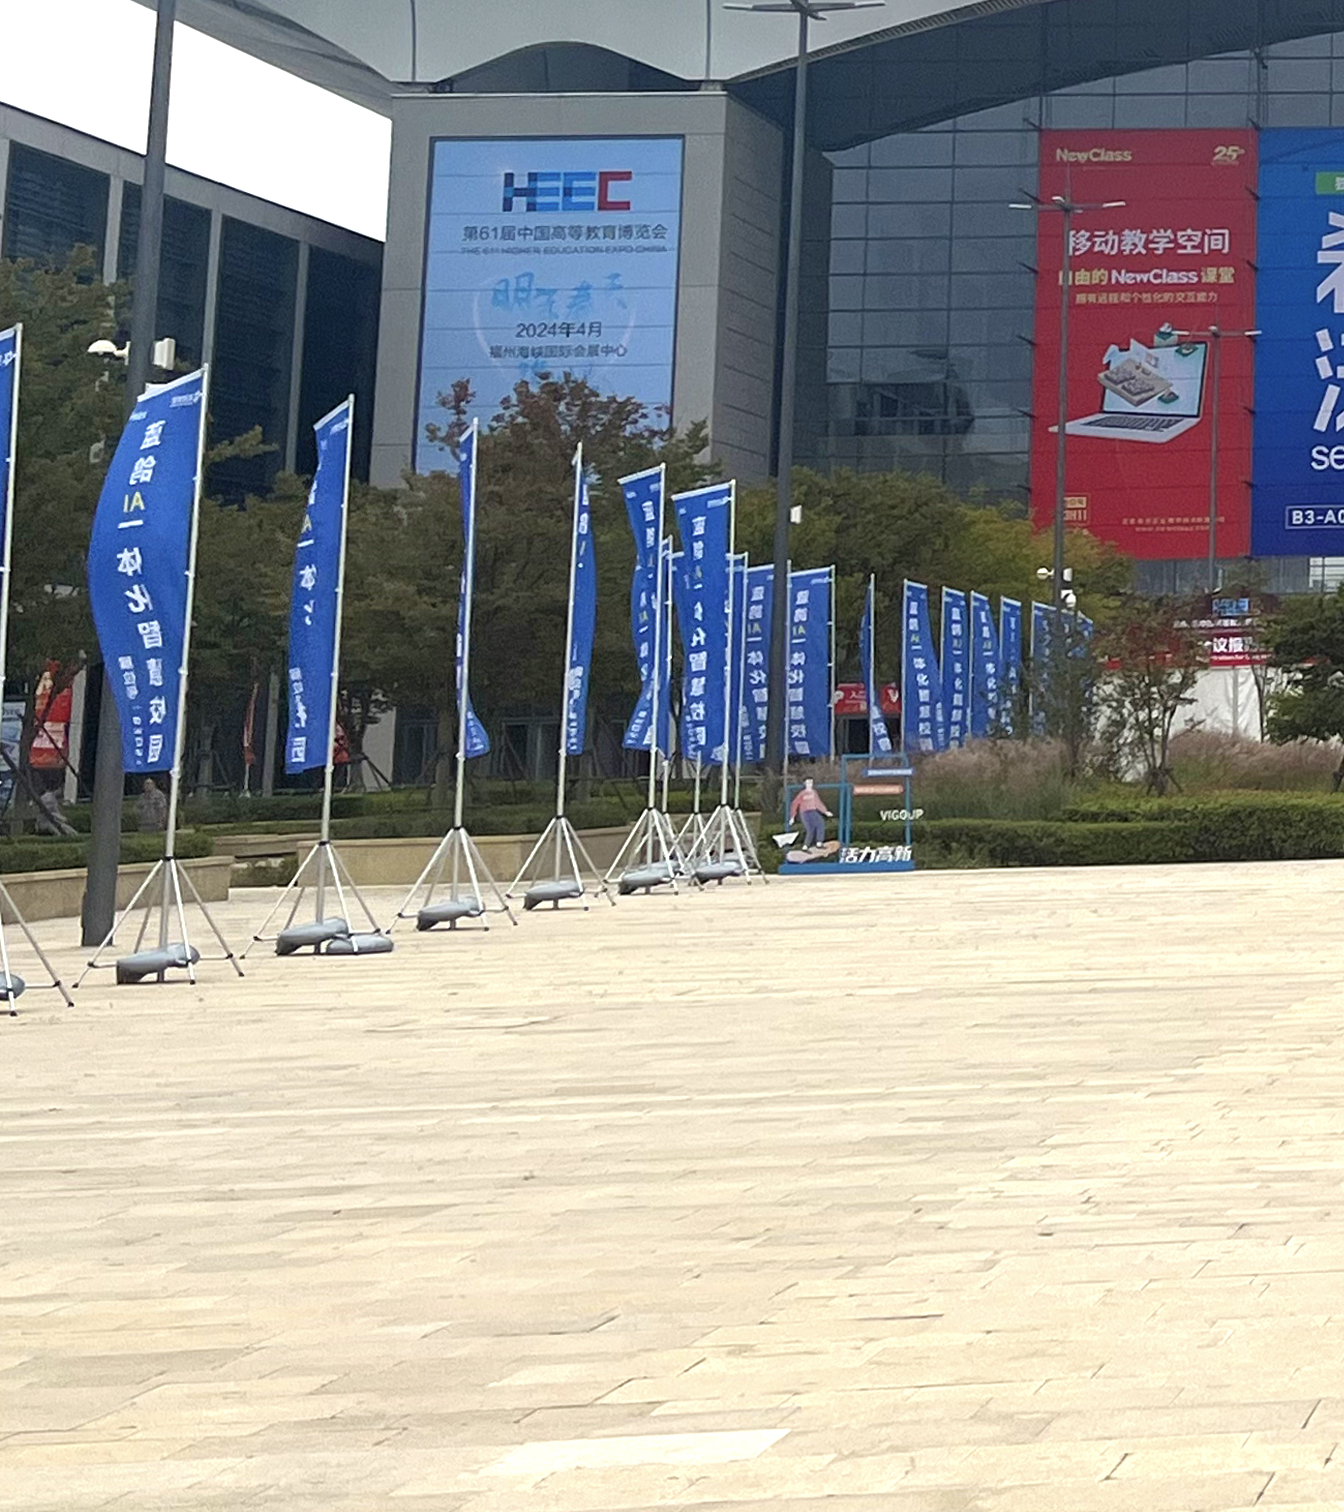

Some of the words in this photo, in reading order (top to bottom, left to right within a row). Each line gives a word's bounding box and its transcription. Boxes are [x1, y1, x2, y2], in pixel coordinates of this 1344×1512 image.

[1056, 148, 1132, 162] NewClass
[503, 171, 632, 212] HEEC
[462, 224, 668, 241] 第61届中国高等教育博览会
[1068, 228, 1230, 256] 移动教学空间
[1111, 269, 1198, 284] NewClass
[1201, 267, 1235, 283] 课堂
[515, 321, 602, 338] 2024年4月
[840, 846, 912, 864] 活力高新
